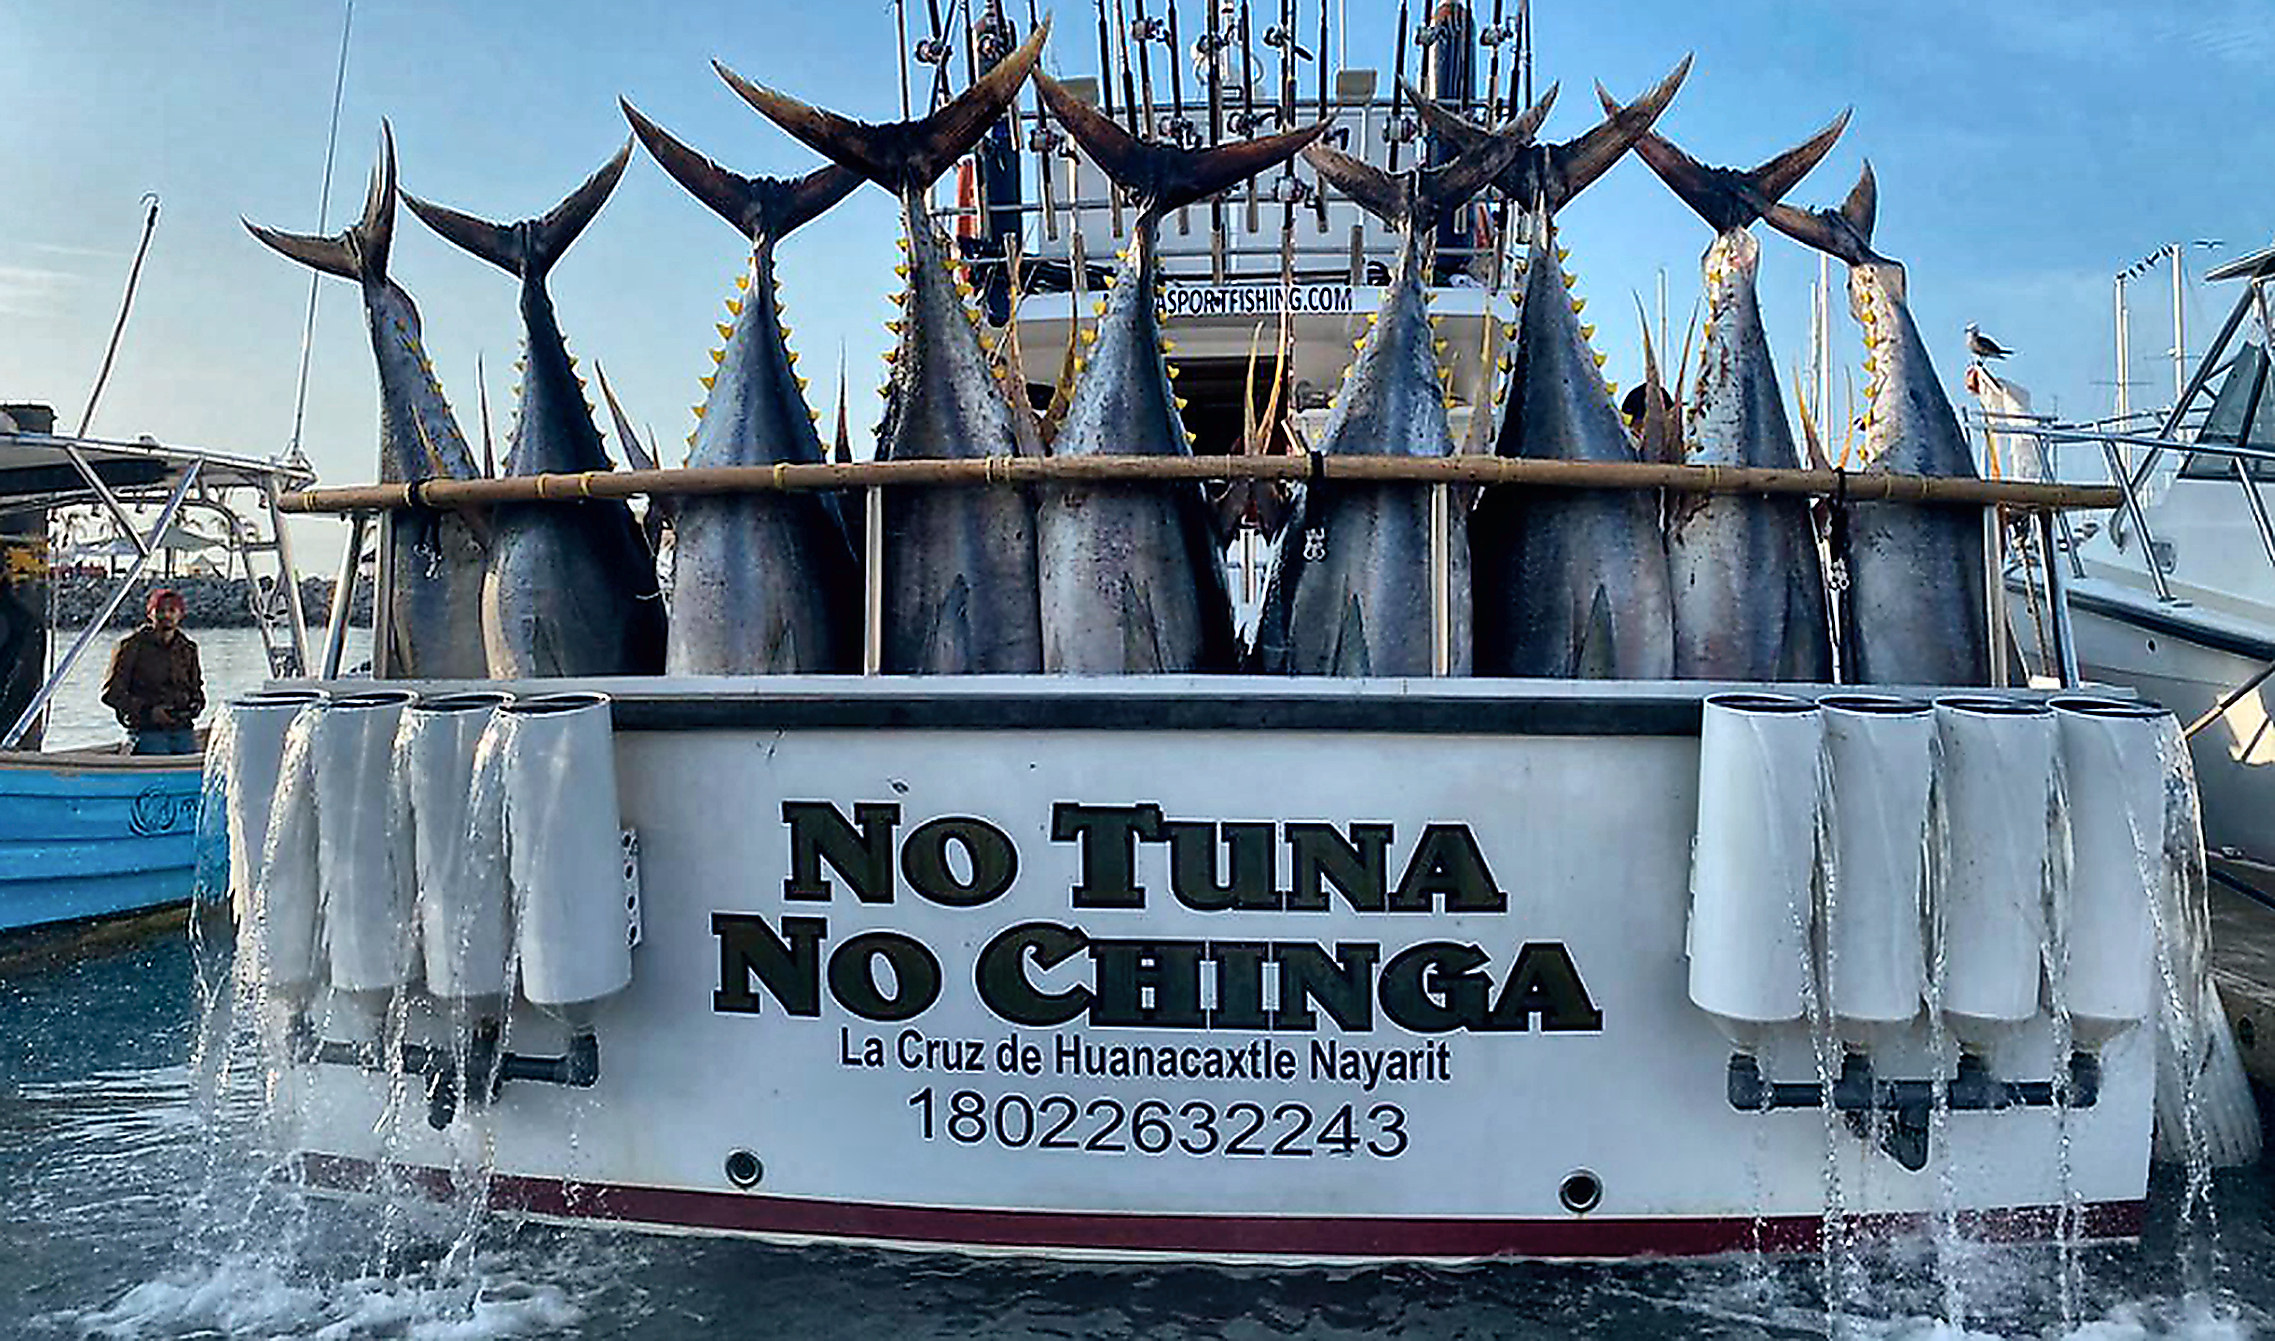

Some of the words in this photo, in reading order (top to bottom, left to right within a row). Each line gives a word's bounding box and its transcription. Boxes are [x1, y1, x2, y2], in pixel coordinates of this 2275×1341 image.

[1155, 286, 1351, 314] ASPORTFISHING.COM
[781, 800, 1020, 908] NO
[1050, 801, 1508, 914] TUNA
[710, 911, 943, 1021] NO
[973, 920, 1604, 1034] CHINGA
[840, 1026, 885, 1067] La
[898, 1028, 986, 1071] Cruz
[995, 1032, 1042, 1075] de
[1055, 1033, 1297, 1081] Huanacaxtle
[1310, 1038, 1452, 1092] Nayarit
[908, 1086, 1410, 1158] 18022632243
